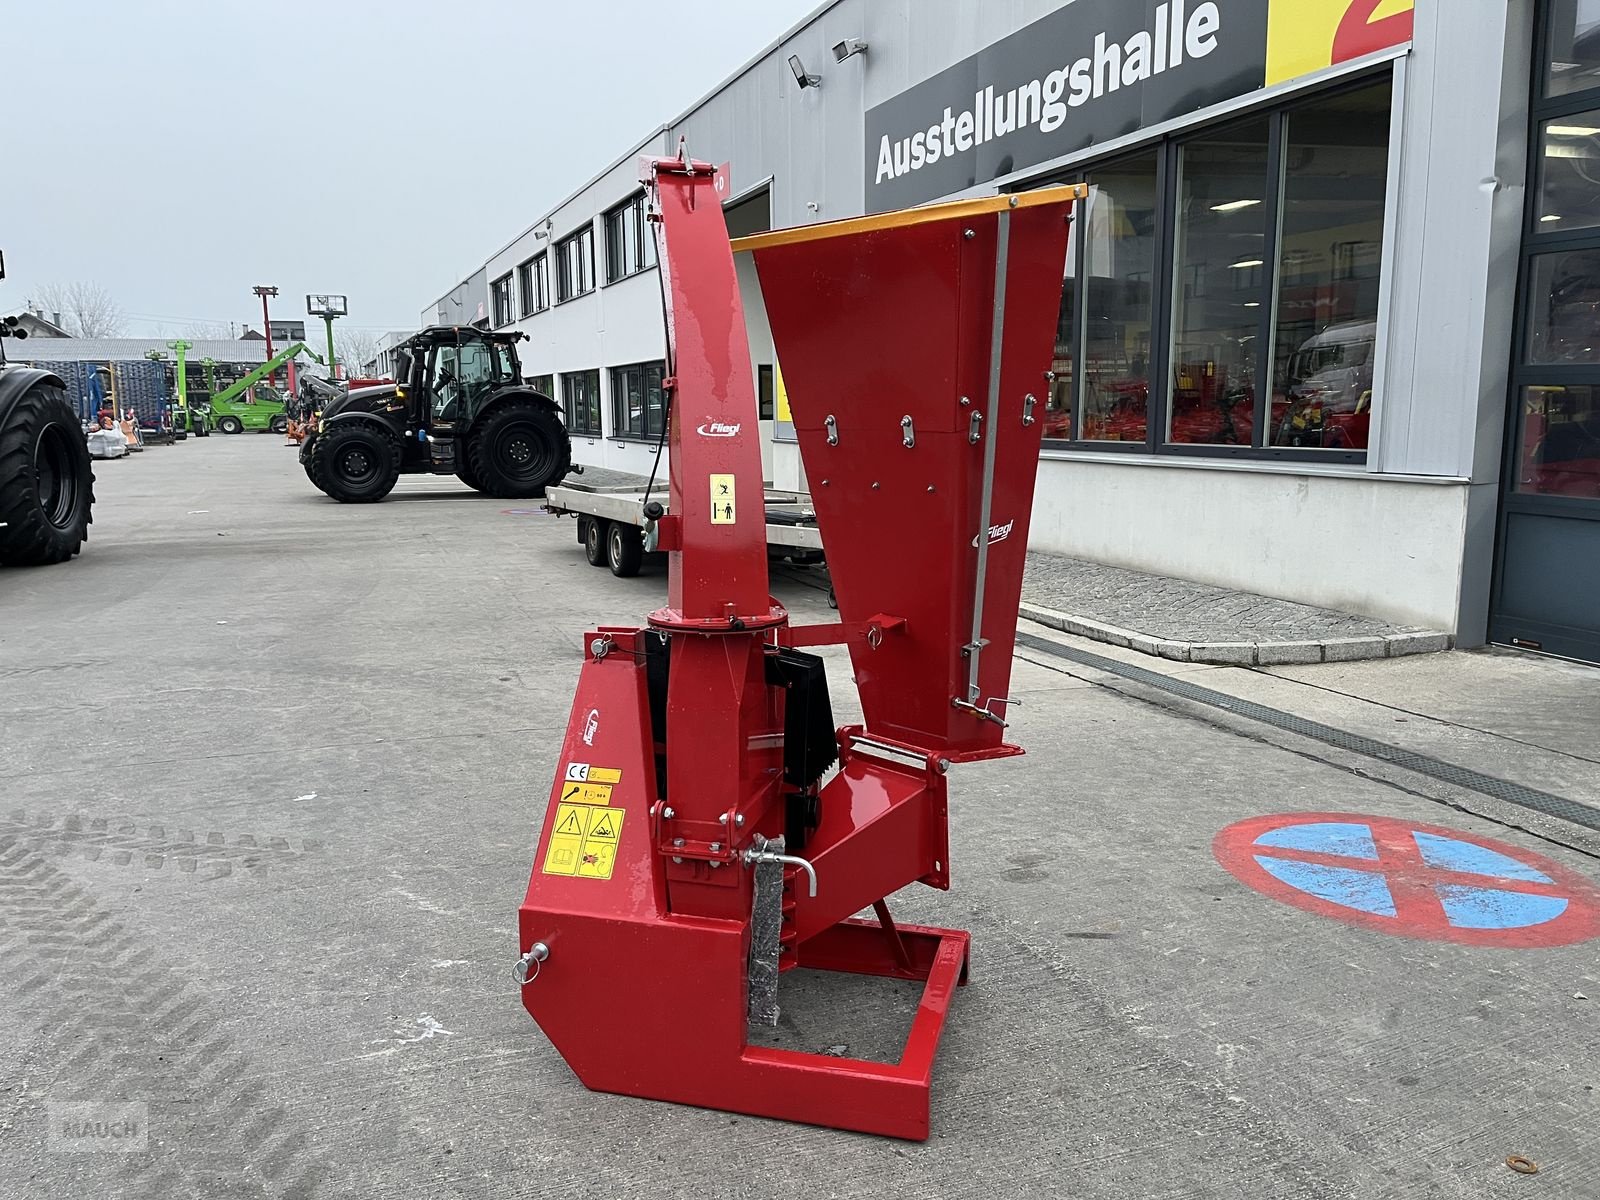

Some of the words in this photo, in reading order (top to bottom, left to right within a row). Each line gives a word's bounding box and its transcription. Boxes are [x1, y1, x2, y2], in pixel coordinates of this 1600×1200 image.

[875, 0, 1220, 185] Ausstellungshalle
[707, 422, 741, 437] Fliegl
[584, 719, 598, 747] Fliegl
